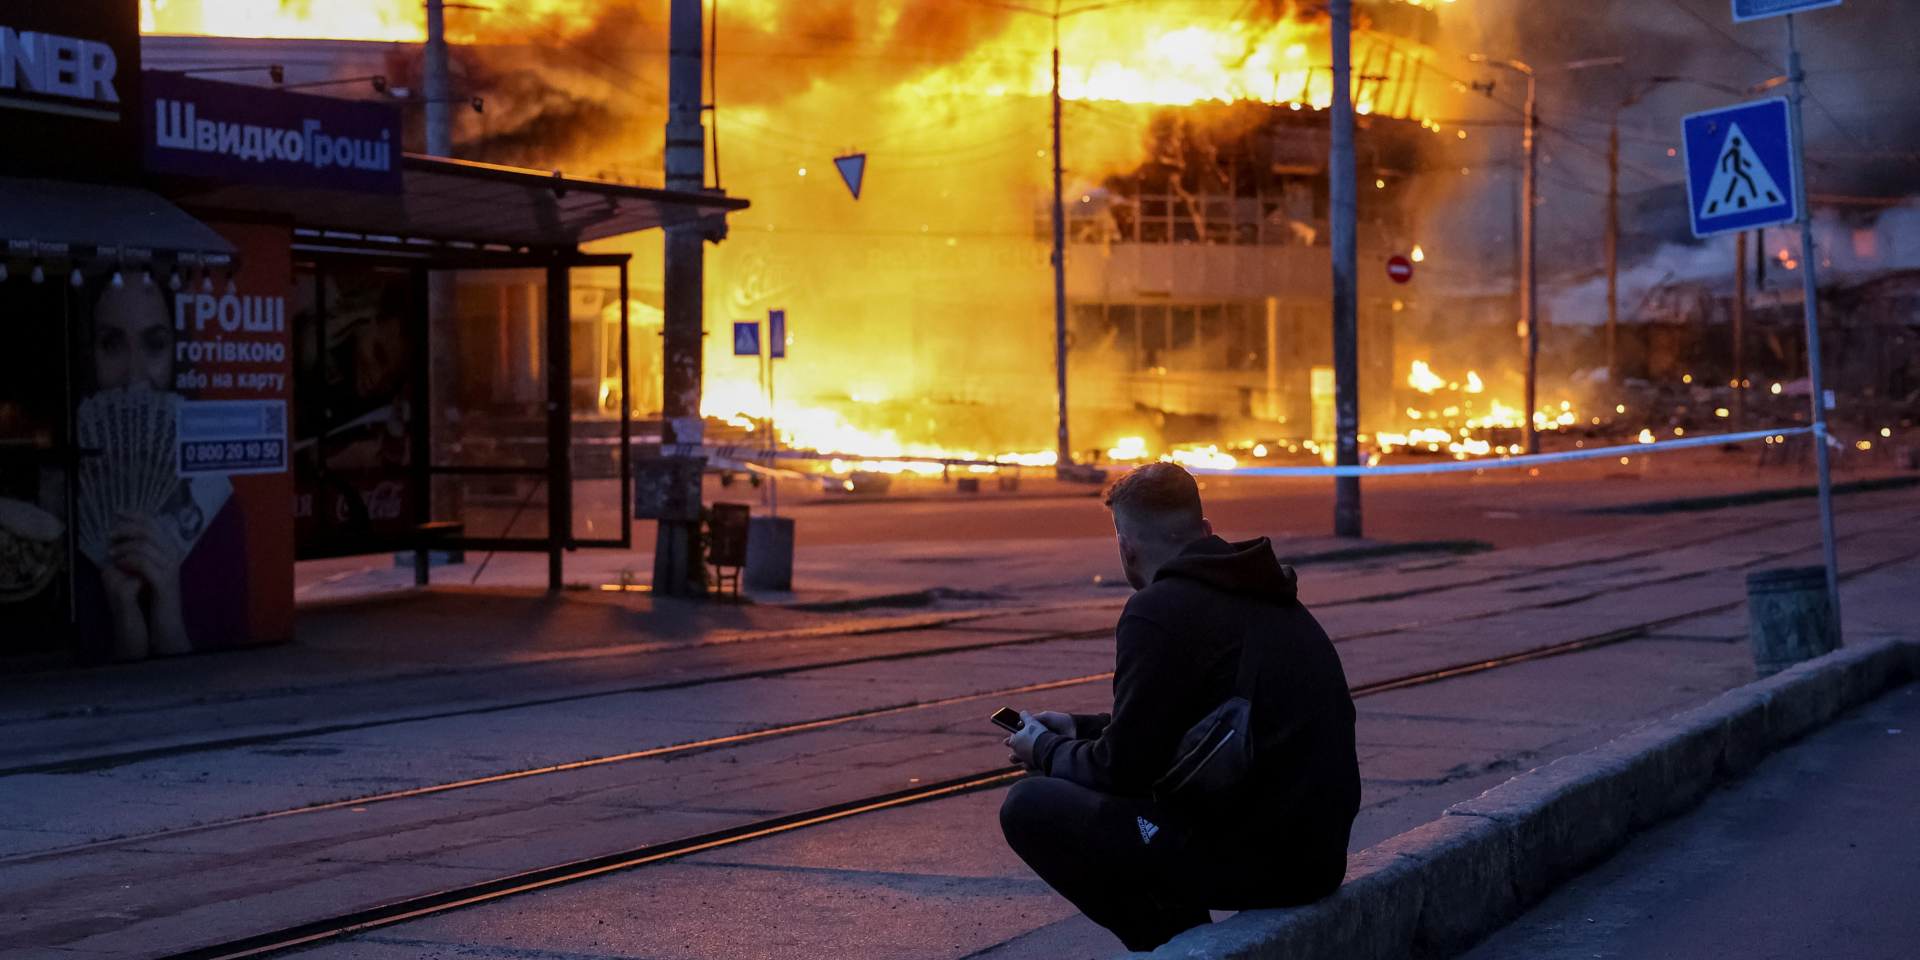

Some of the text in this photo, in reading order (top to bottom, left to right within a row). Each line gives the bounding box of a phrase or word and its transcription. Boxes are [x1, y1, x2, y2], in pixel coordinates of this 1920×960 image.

[155, 98, 391, 171] ШвидкоГроші
[174, 293, 285, 332] ГРОШІ
[175, 335, 286, 363] готівкою
[176, 369, 286, 392] або на карту
[185, 441, 280, 462] 0 800 20 10 50
[1136, 815, 1150, 844] adidas
